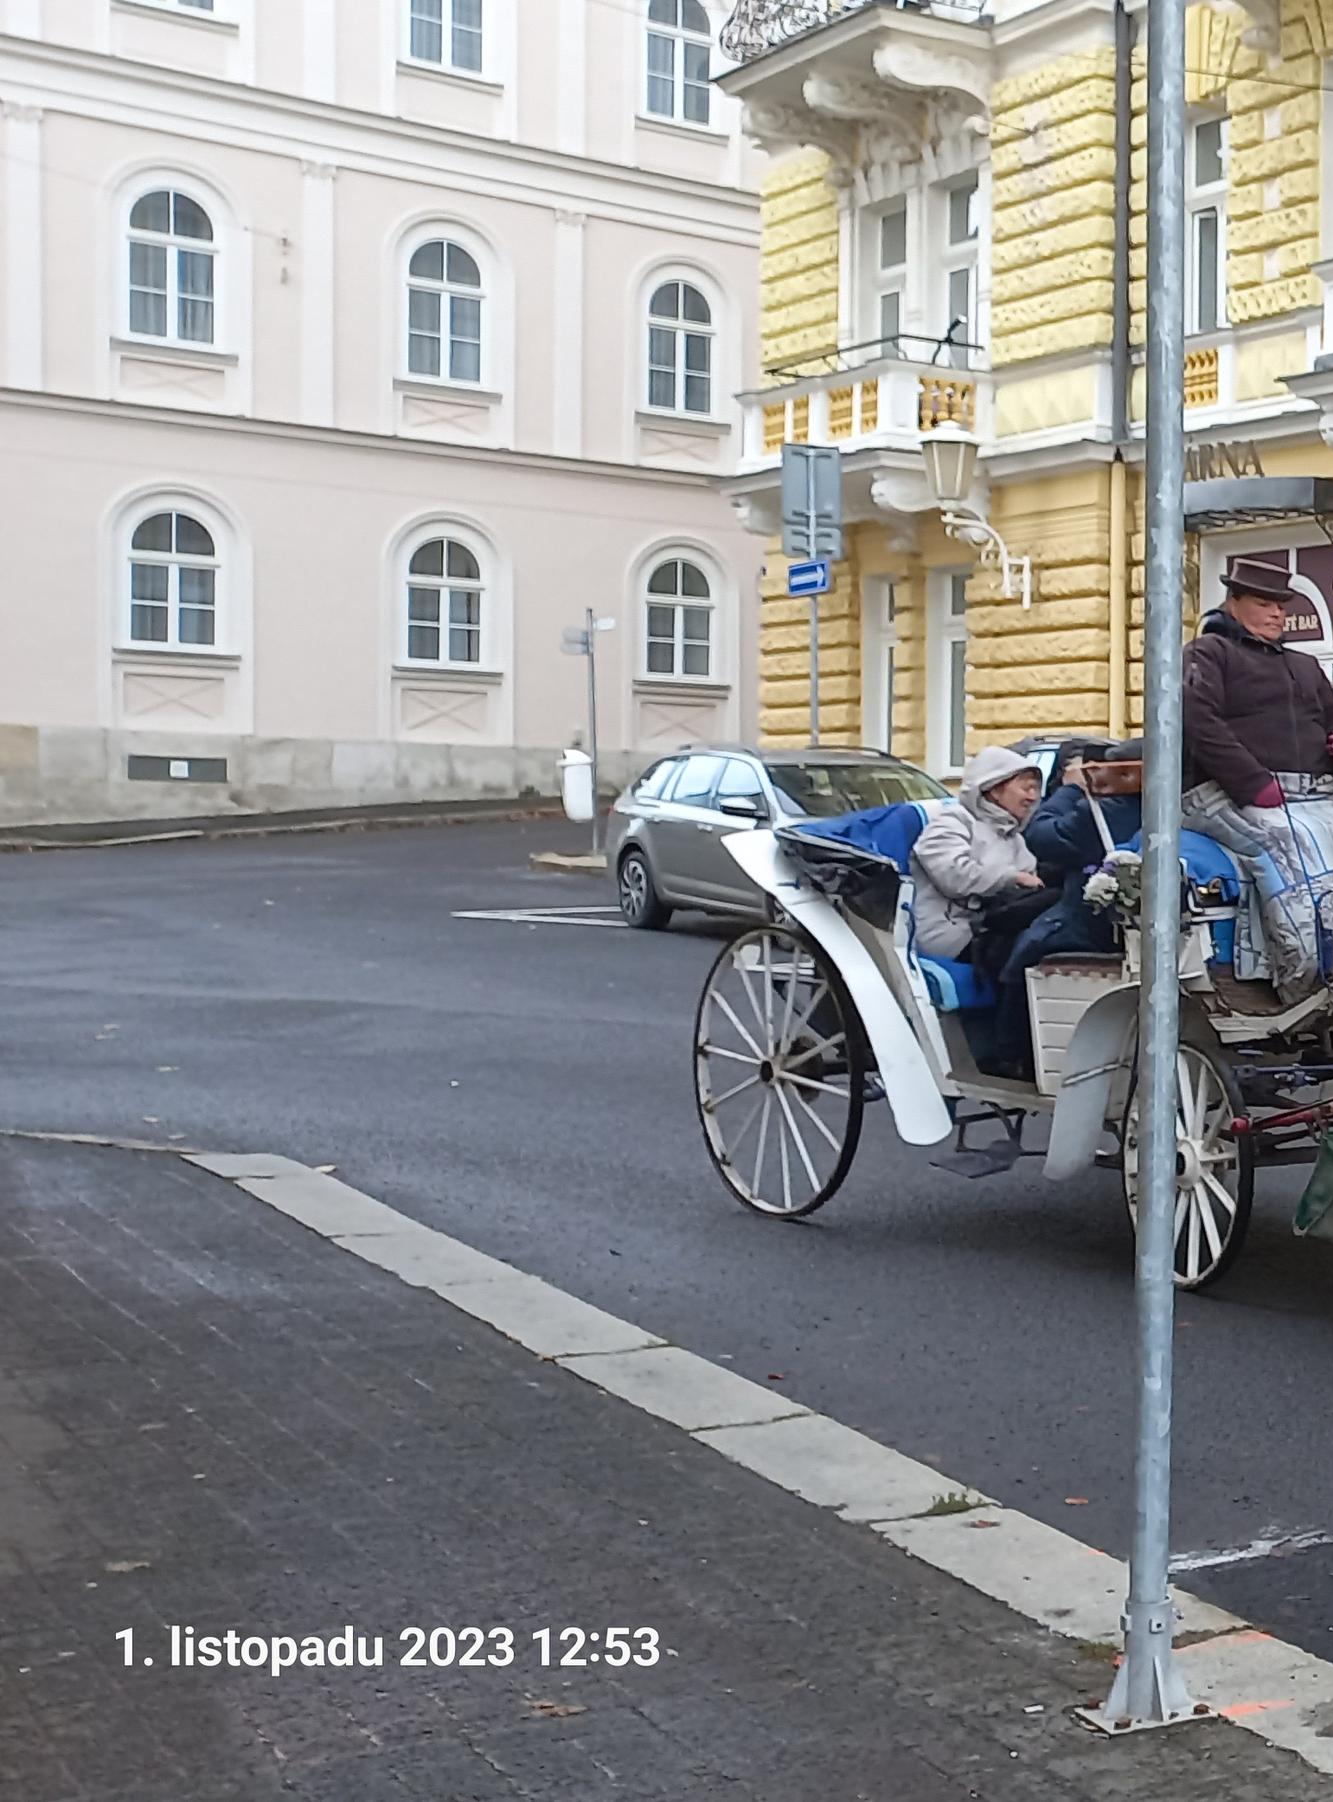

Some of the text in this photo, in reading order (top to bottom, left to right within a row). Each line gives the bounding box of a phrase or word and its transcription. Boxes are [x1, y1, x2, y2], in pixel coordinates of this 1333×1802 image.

[1184, 436, 1265, 482] ÁRNA
[1283, 613, 1319, 632] FÉ BAR
